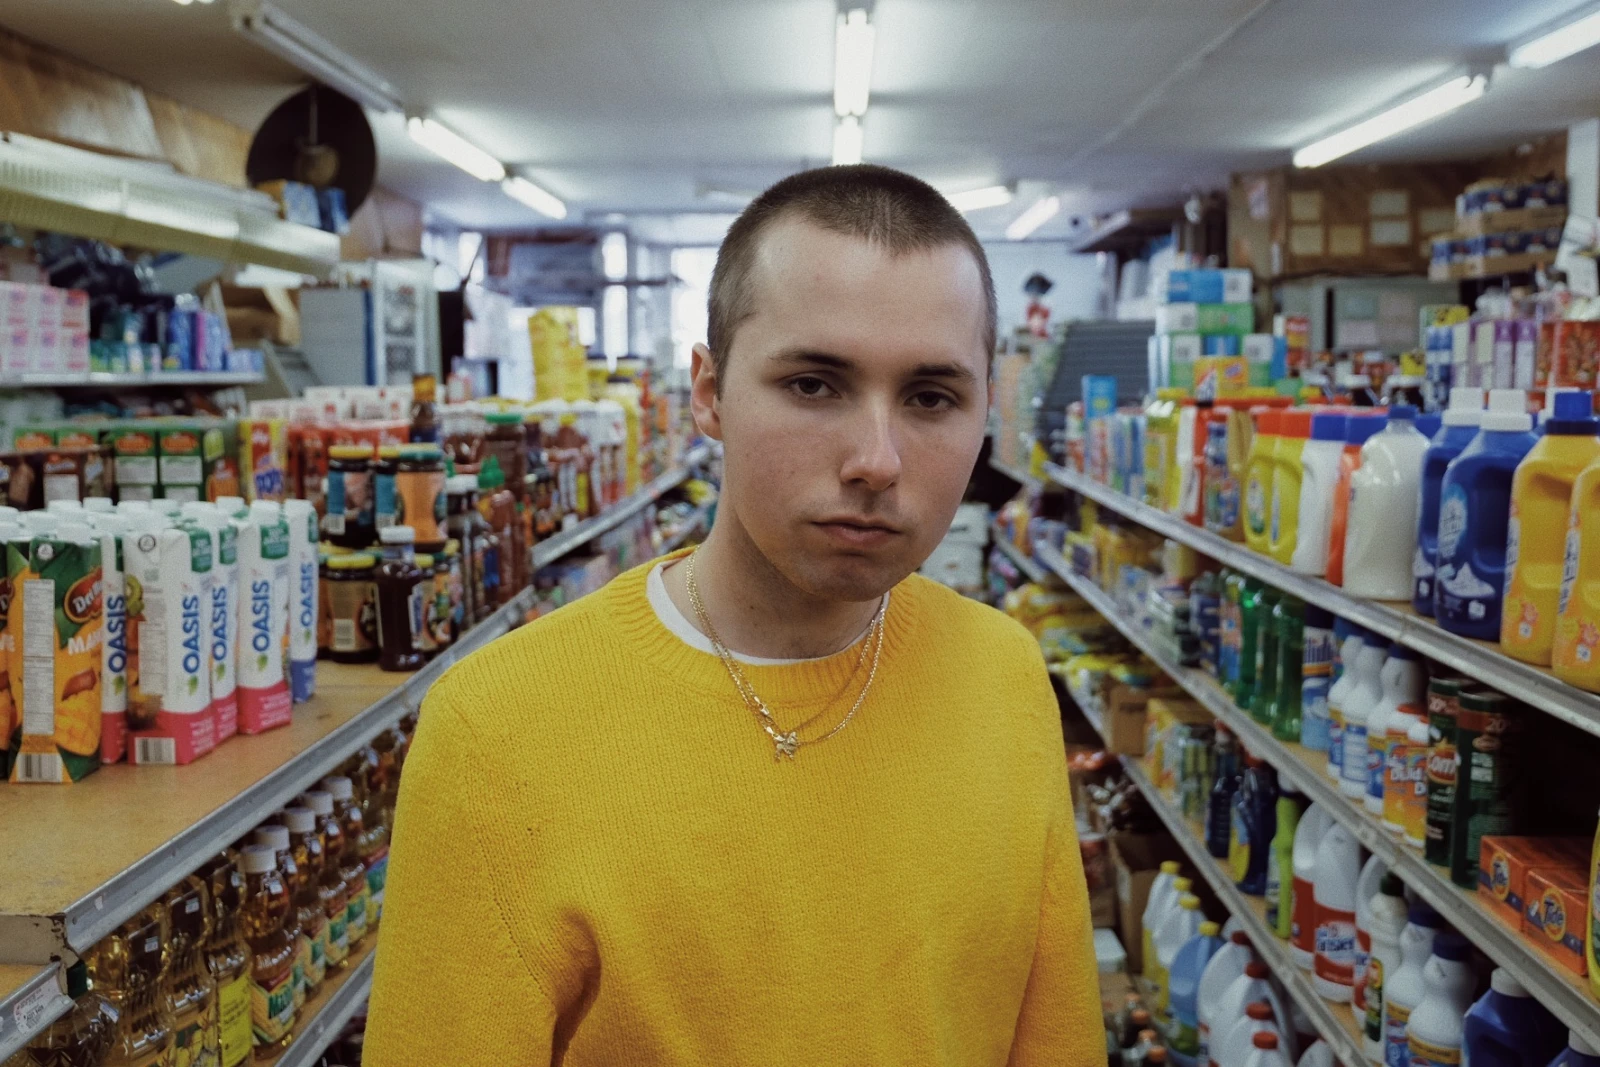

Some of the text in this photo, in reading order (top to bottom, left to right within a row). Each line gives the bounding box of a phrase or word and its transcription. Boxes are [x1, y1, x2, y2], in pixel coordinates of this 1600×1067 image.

[212, 586, 228, 661] OASIS
[252, 580, 270, 652] OASIS
[301, 563, 314, 627] OASIS
[107, 595, 127, 673] OASIS
[182, 595, 201, 673] OASIS
[1543, 900, 1564, 925] Tide
